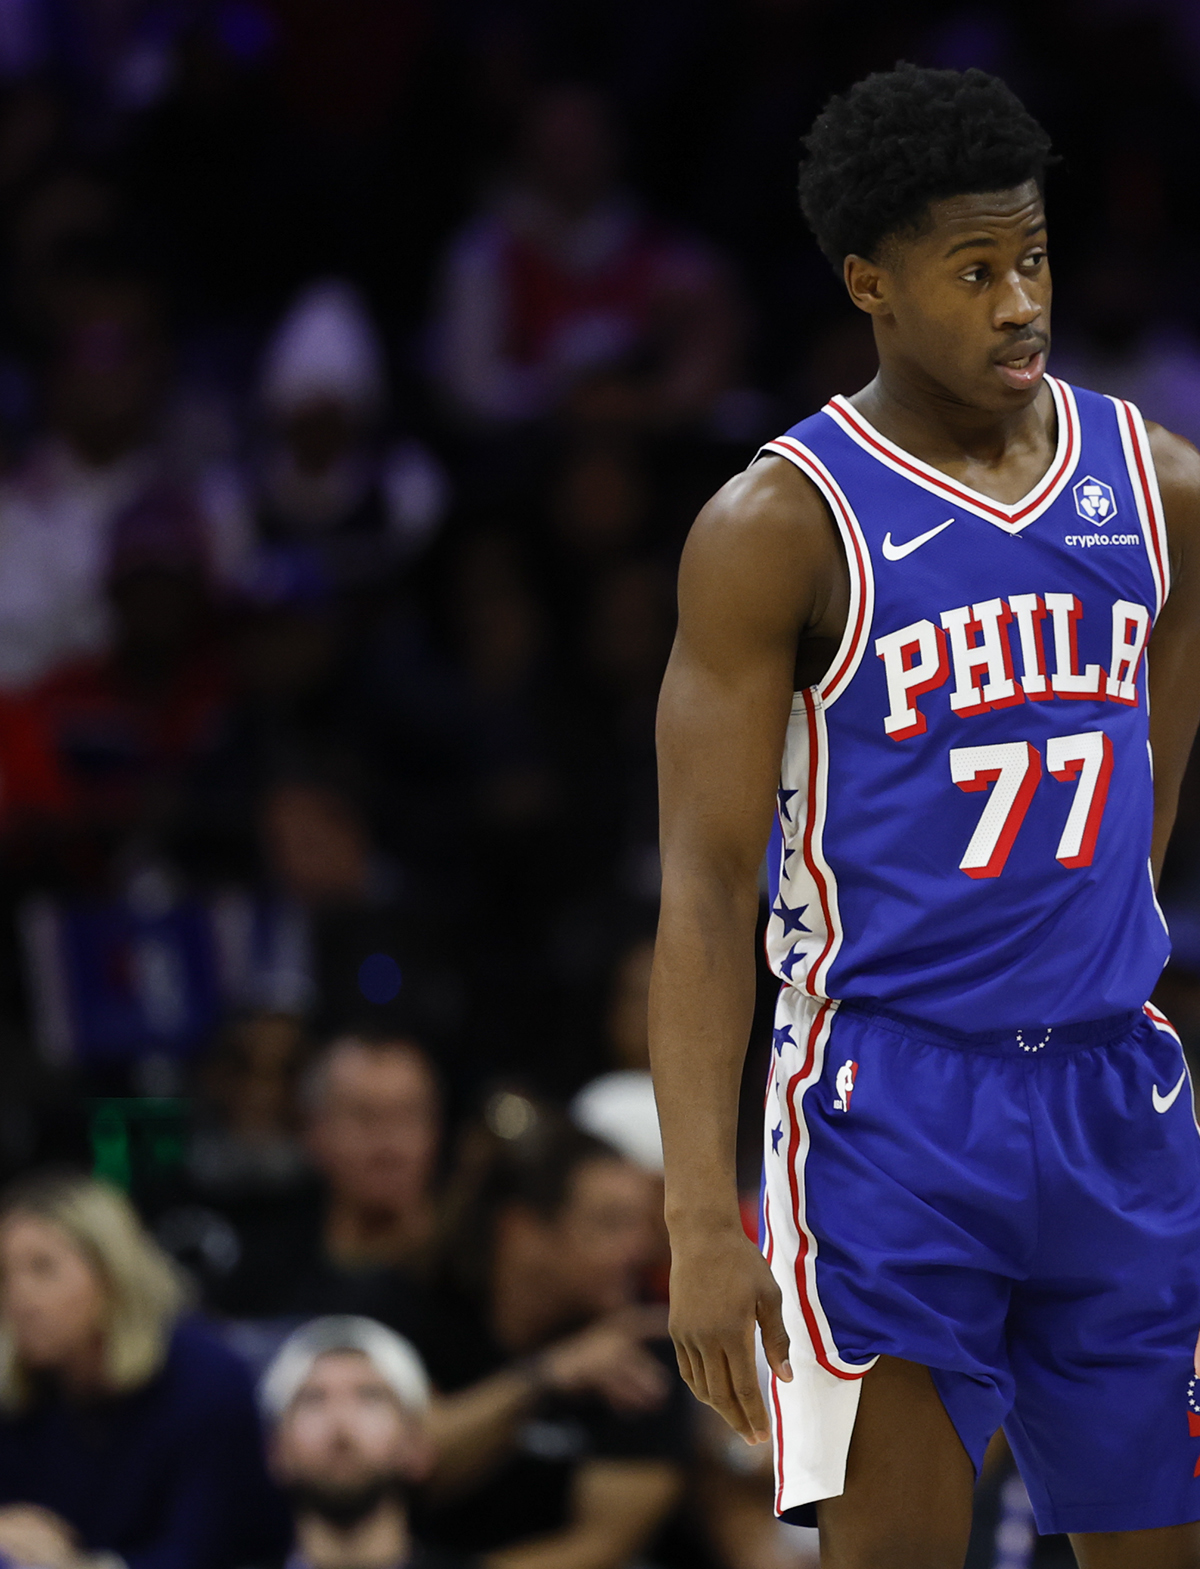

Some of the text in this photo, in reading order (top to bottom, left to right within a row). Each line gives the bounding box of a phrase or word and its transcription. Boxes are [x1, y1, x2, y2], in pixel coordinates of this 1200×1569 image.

[1065, 533, 1139, 548] crypto.com
[875, 593, 1152, 742] PHILA
[950, 731, 1114, 879] 77
